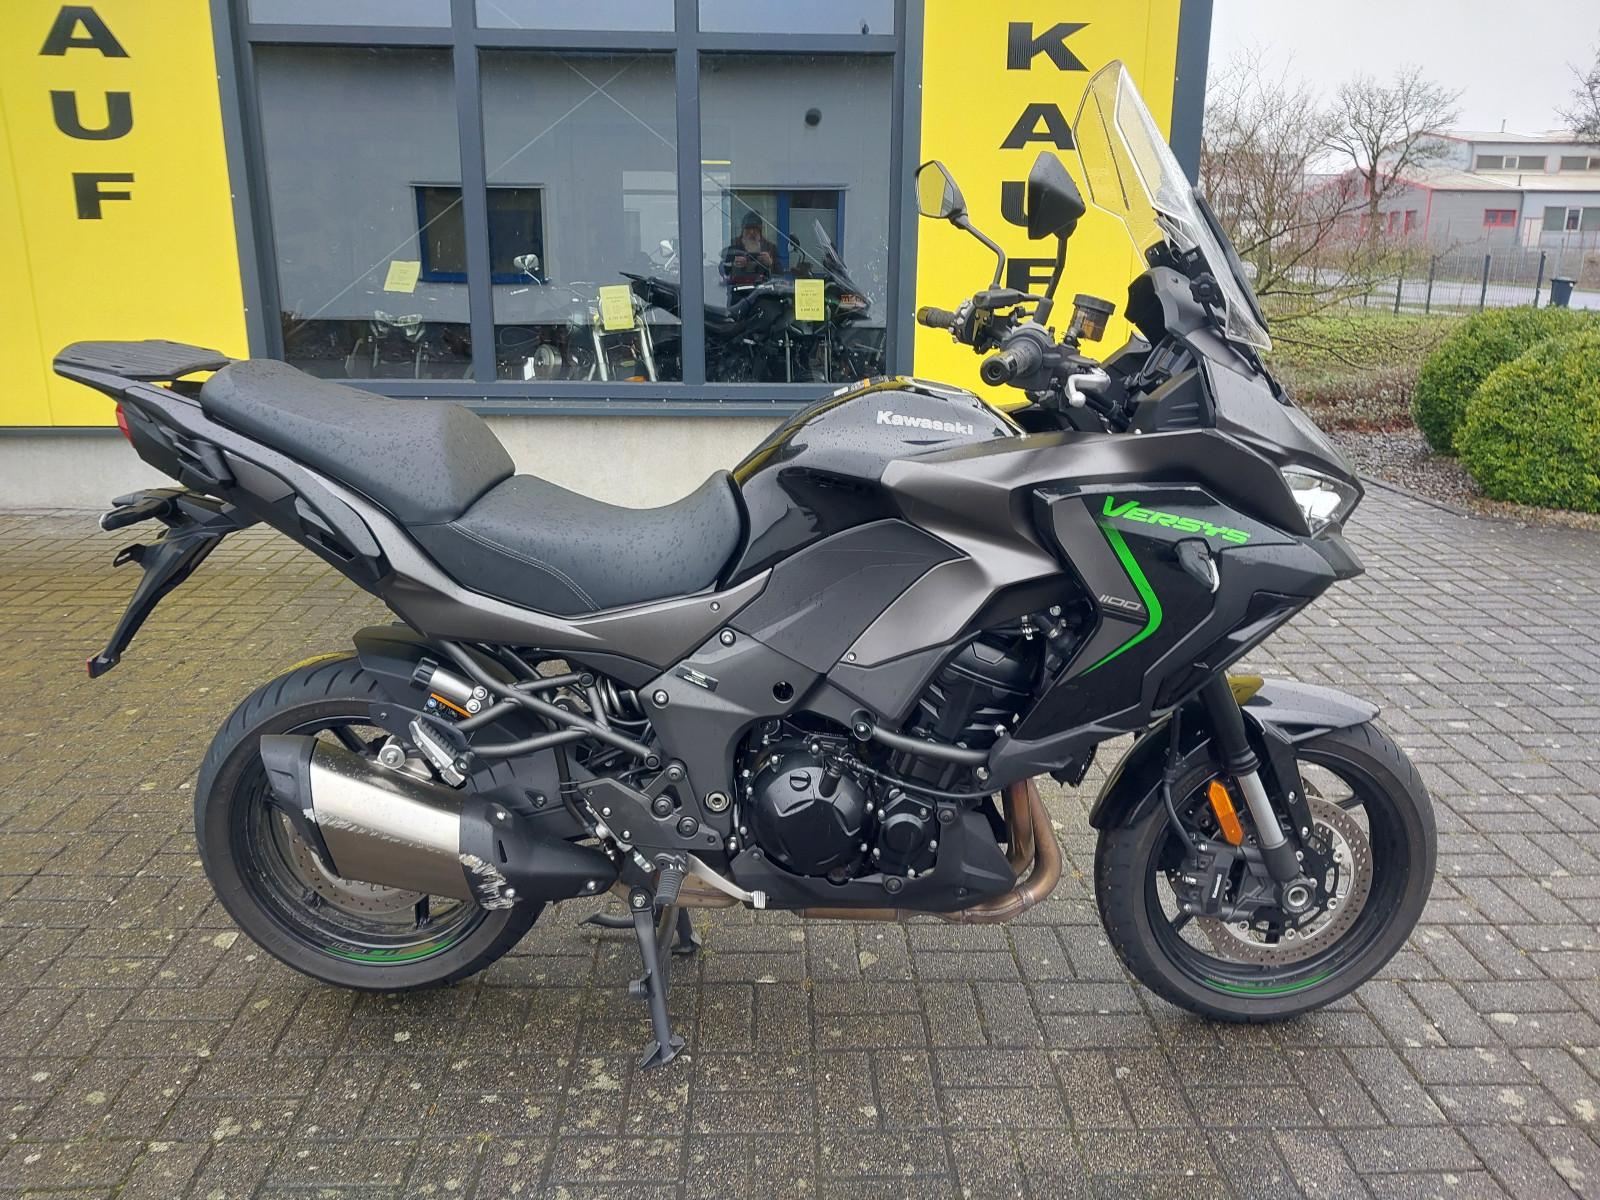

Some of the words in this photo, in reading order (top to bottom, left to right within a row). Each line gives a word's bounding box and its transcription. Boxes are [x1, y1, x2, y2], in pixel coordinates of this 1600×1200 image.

[39, 5, 135, 219] AUF
[877, 410, 973, 435] Kawasaki
[1100, 594, 1141, 610] 1100
